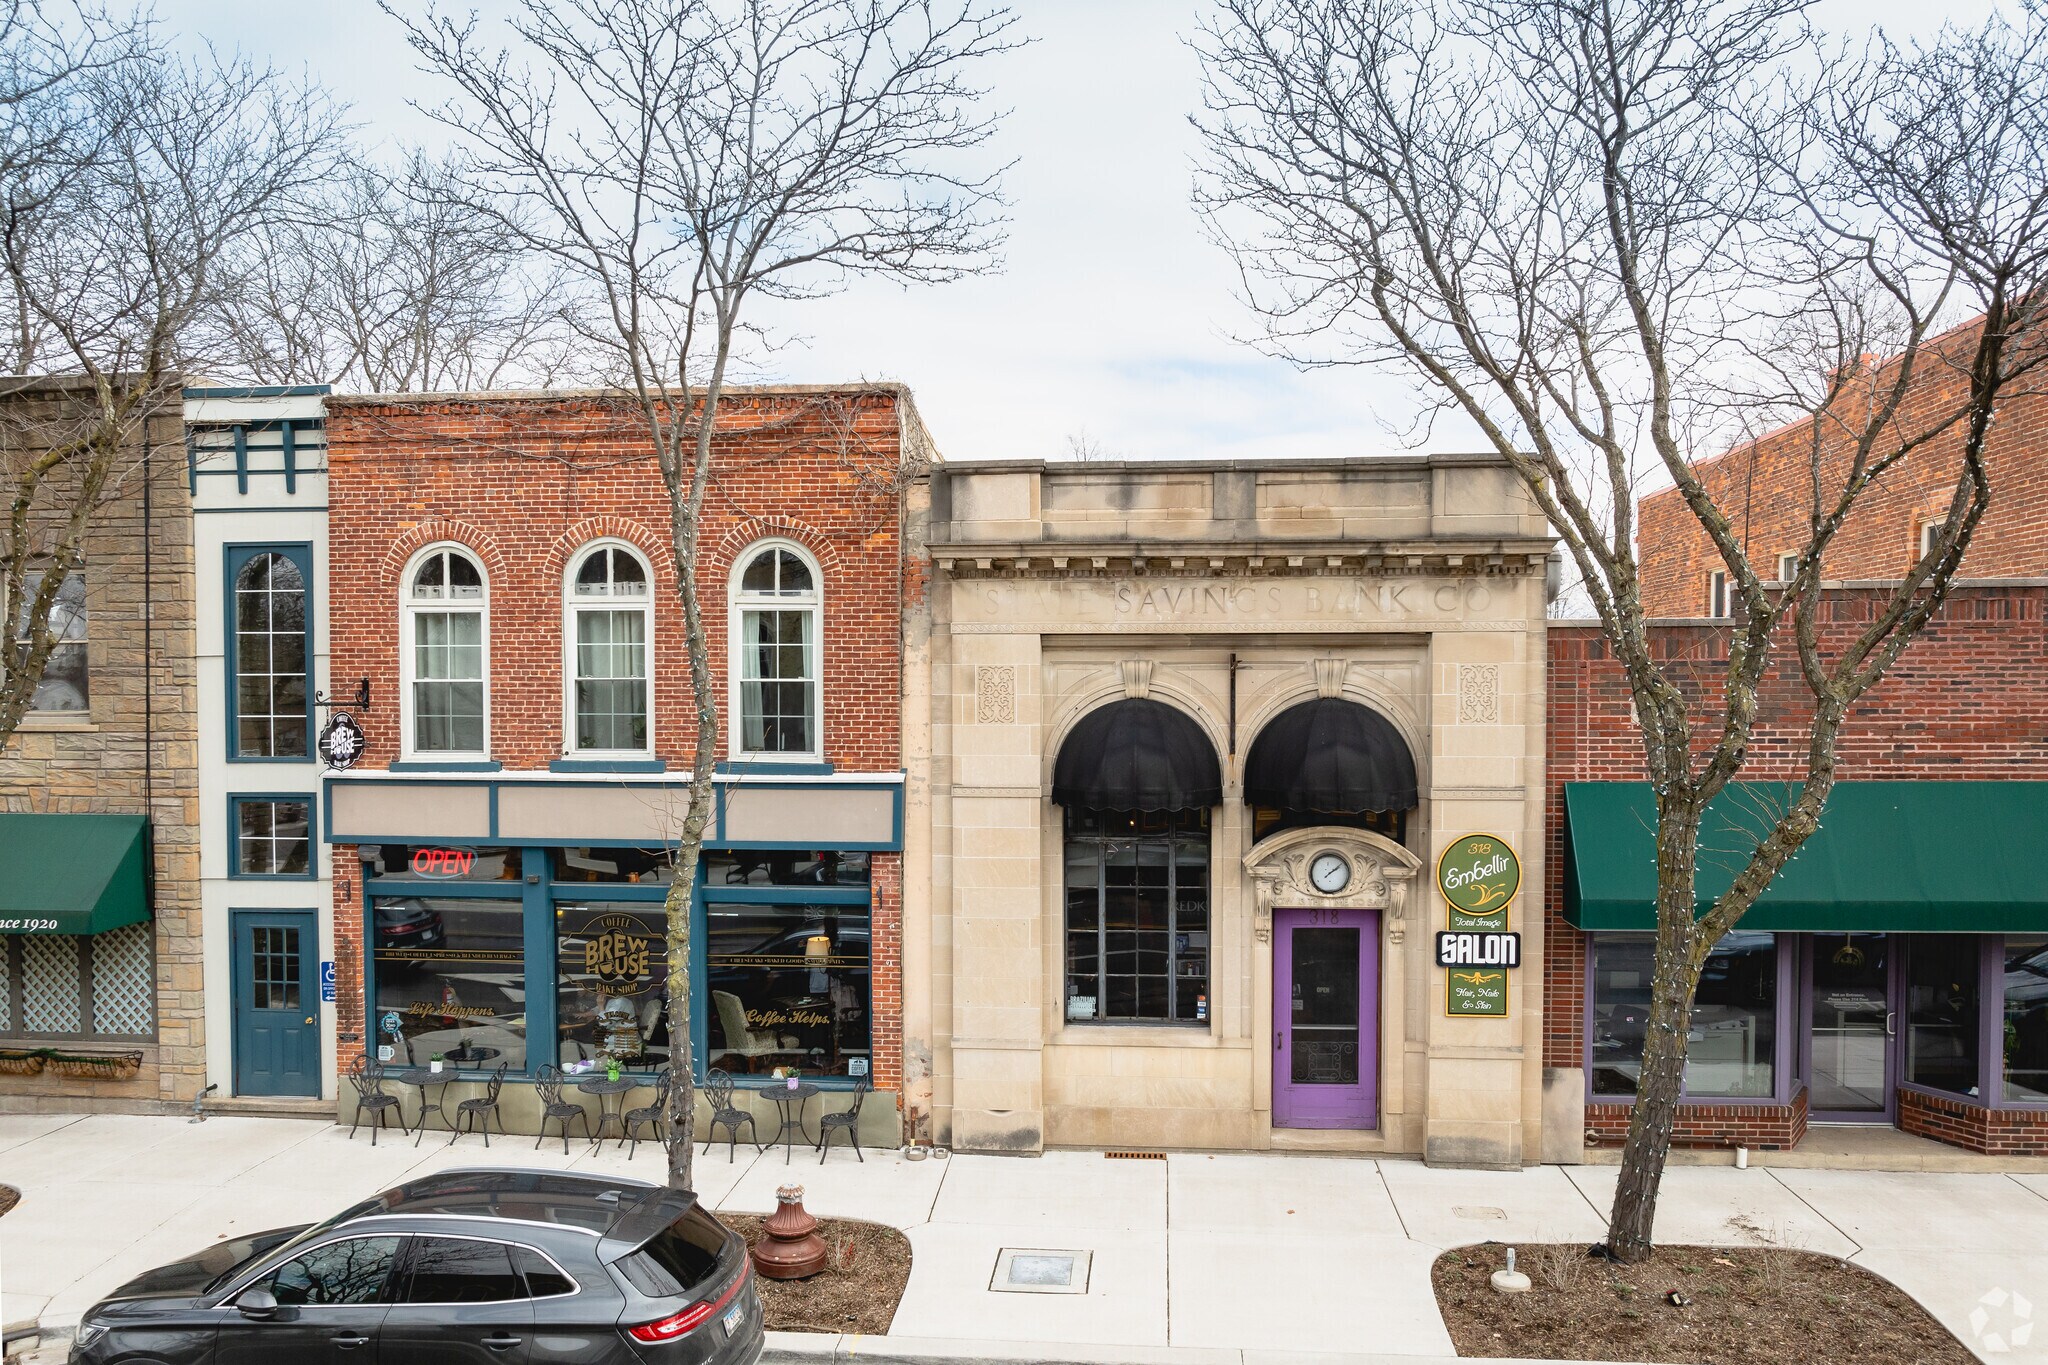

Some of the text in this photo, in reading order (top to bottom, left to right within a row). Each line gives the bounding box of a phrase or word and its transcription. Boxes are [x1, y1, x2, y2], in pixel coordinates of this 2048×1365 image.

[985, 585, 1492, 615] STATE SAVINGS BANK CO
[331, 726, 355, 749] BREW
[330, 740, 355, 755] HOUSE
[1467, 843, 1492, 854] 318
[413, 848, 473, 875] OPEN
[1445, 854, 1510, 889] Embellir
[22, 918, 58, 932] 1920
[601, 917, 632, 929] COFFEE
[1308, 908, 1340, 925] 318
[1455, 916, 1502, 929] Total Image
[585, 933, 649, 967] BREW
[1441, 934, 1516, 965] SALON
[585, 949, 650, 975] HOUSE
[595, 982, 639, 994] BAKE SHOP
[1455, 987, 1500, 998] Hair, Nails
[408, 1002, 495, 1019] Life Happens.
[1475, 1000, 1492, 1010] Skin
[745, 1008, 830, 1027] Coffee Helps.
